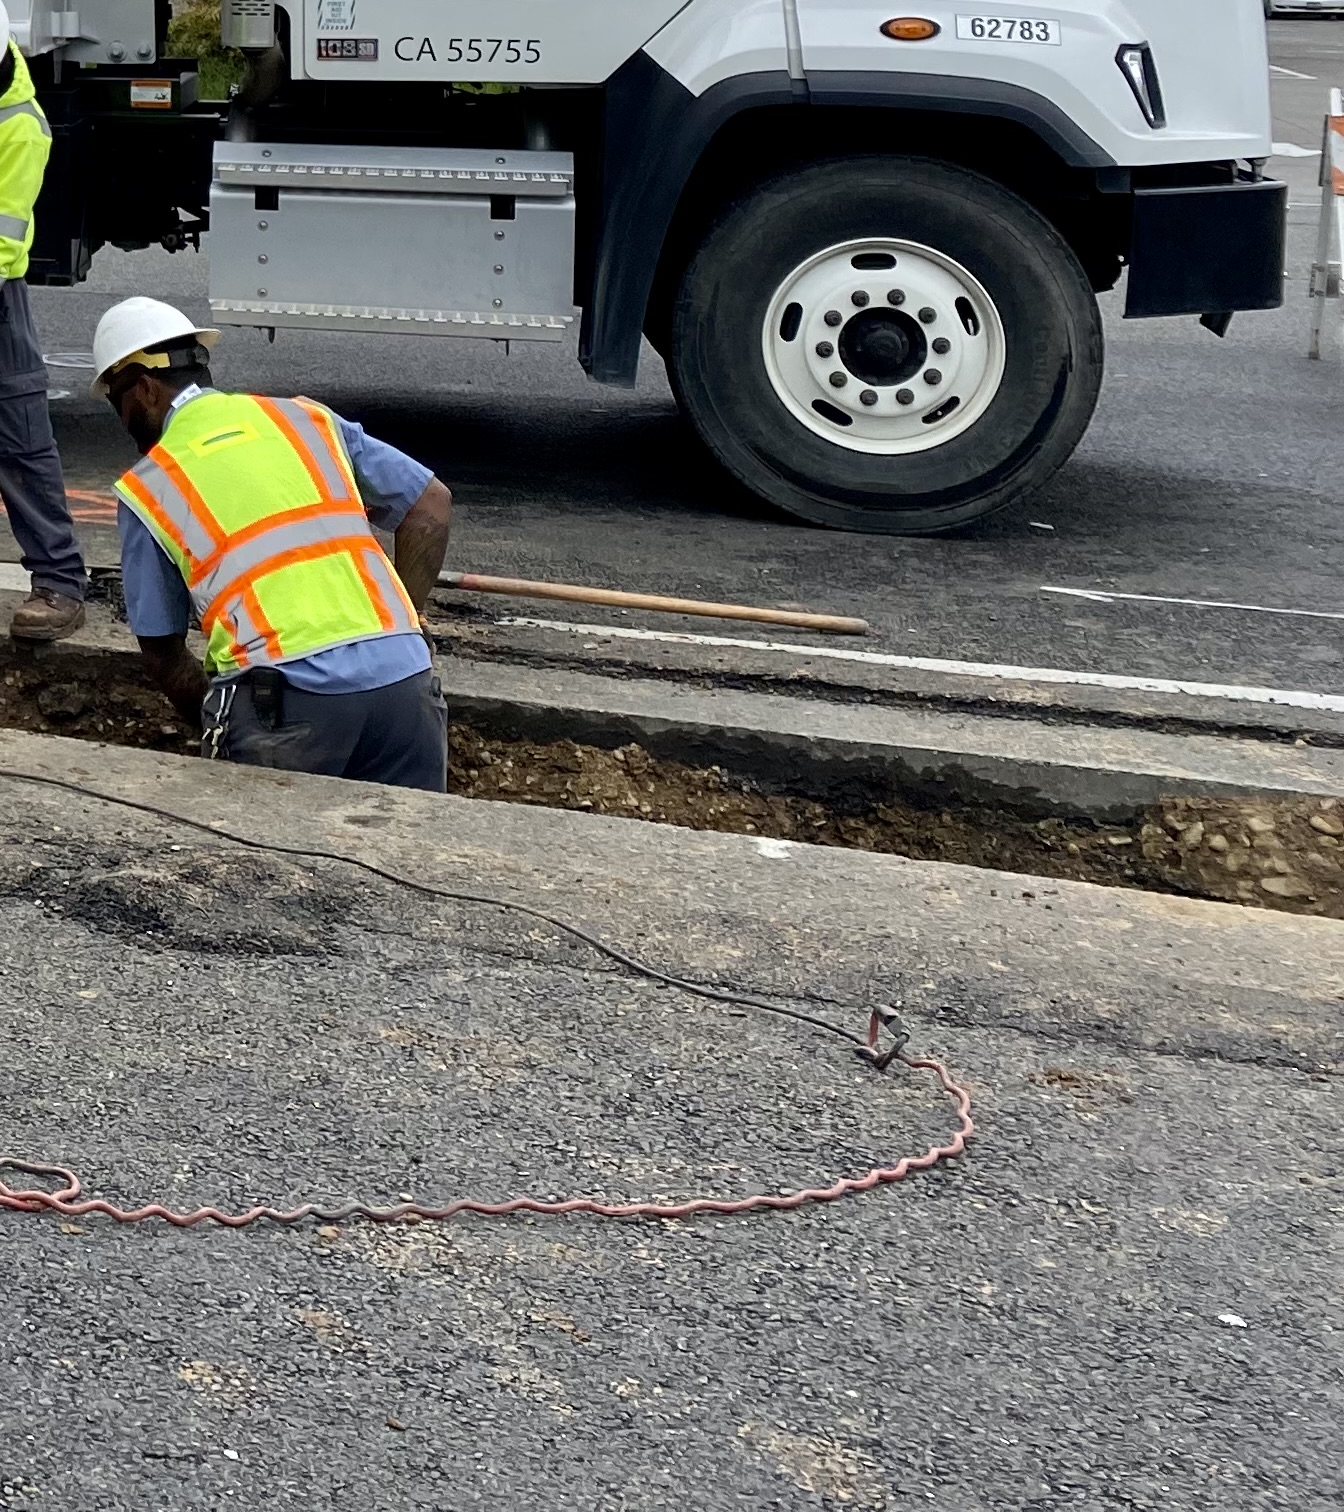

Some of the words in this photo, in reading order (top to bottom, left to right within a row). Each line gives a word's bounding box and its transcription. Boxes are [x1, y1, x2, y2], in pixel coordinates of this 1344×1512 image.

[970, 16, 1051, 43] 62783
[394, 36, 438, 63] CA
[447, 38, 542, 64] 55755
